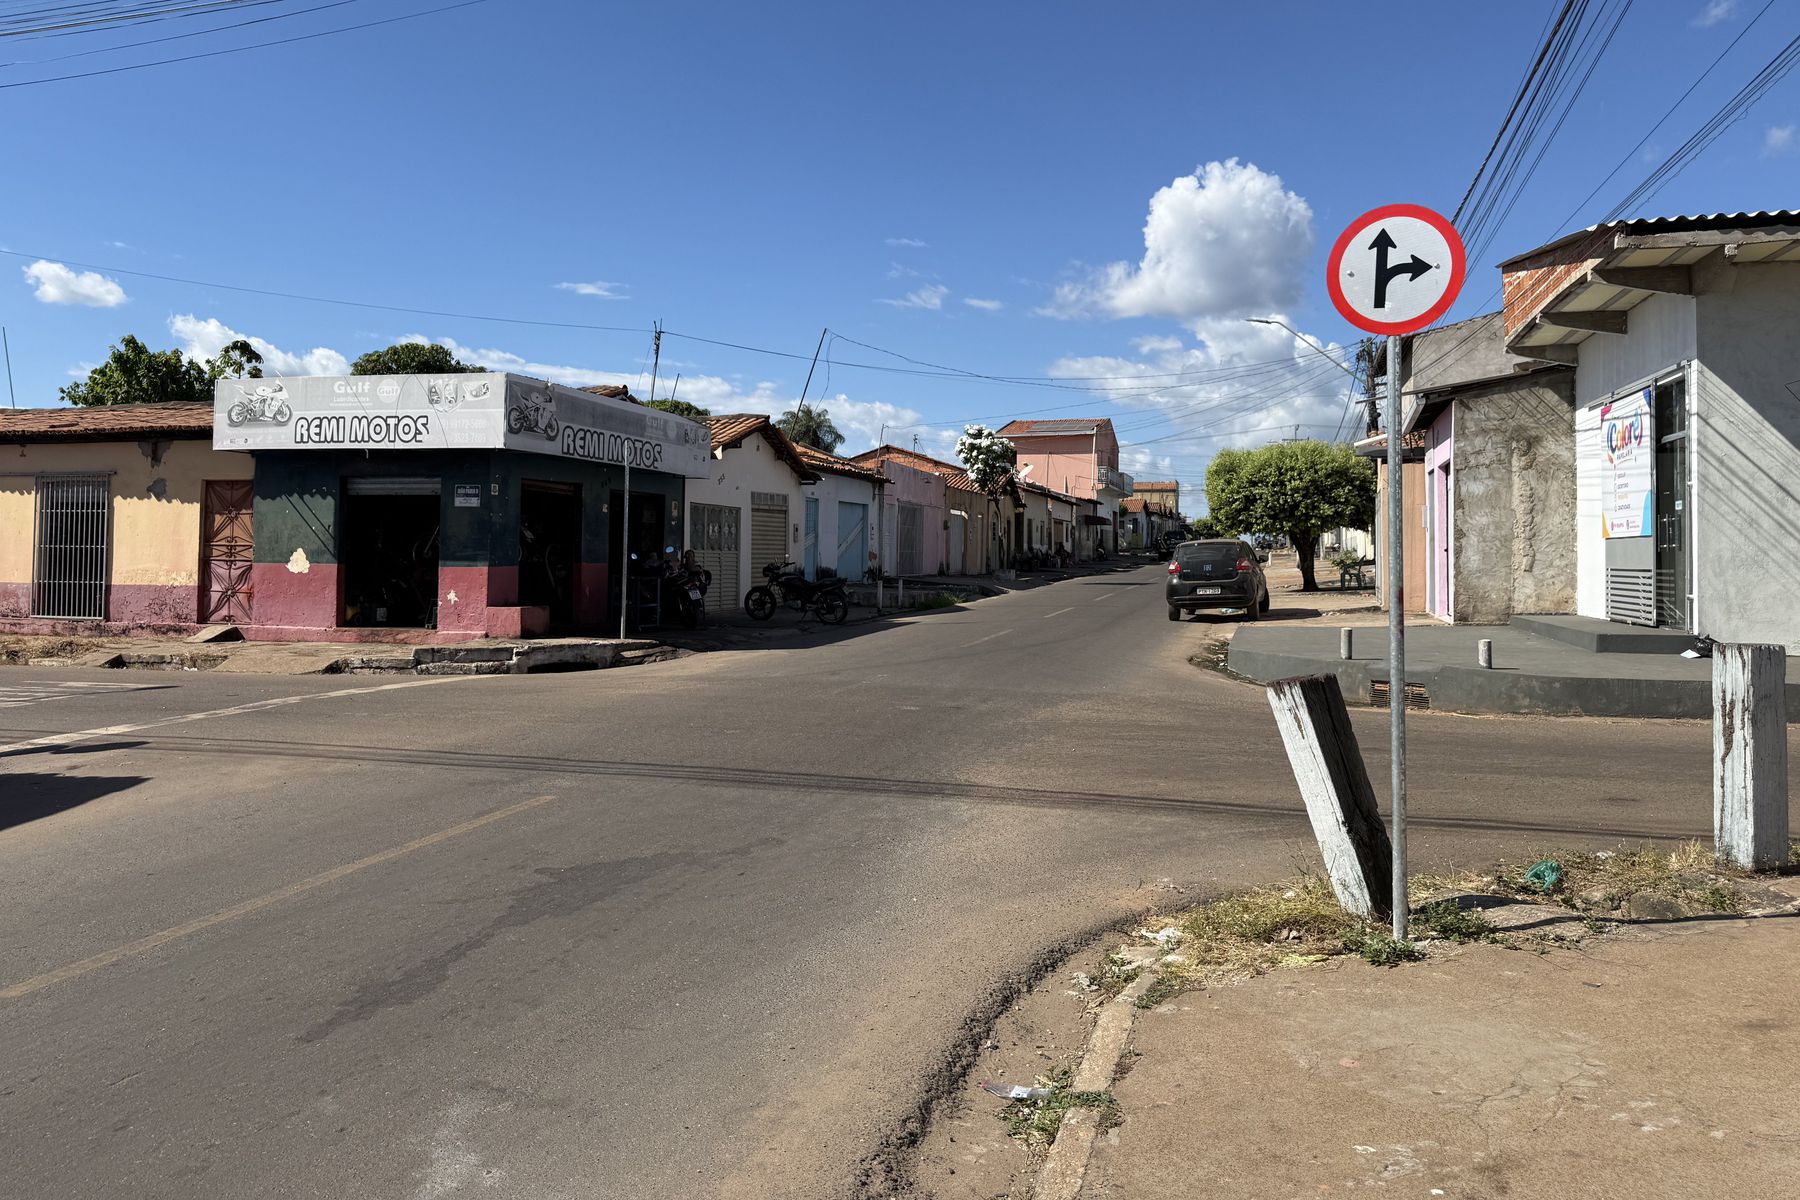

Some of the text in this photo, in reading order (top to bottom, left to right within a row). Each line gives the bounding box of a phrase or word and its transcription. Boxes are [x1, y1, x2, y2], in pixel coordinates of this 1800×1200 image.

[333, 380, 370, 394] Gulf
[295, 416, 345, 444] REMI
[349, 414, 430, 443] MOTOS
[562, 426, 662, 469] REMI MOTOS
